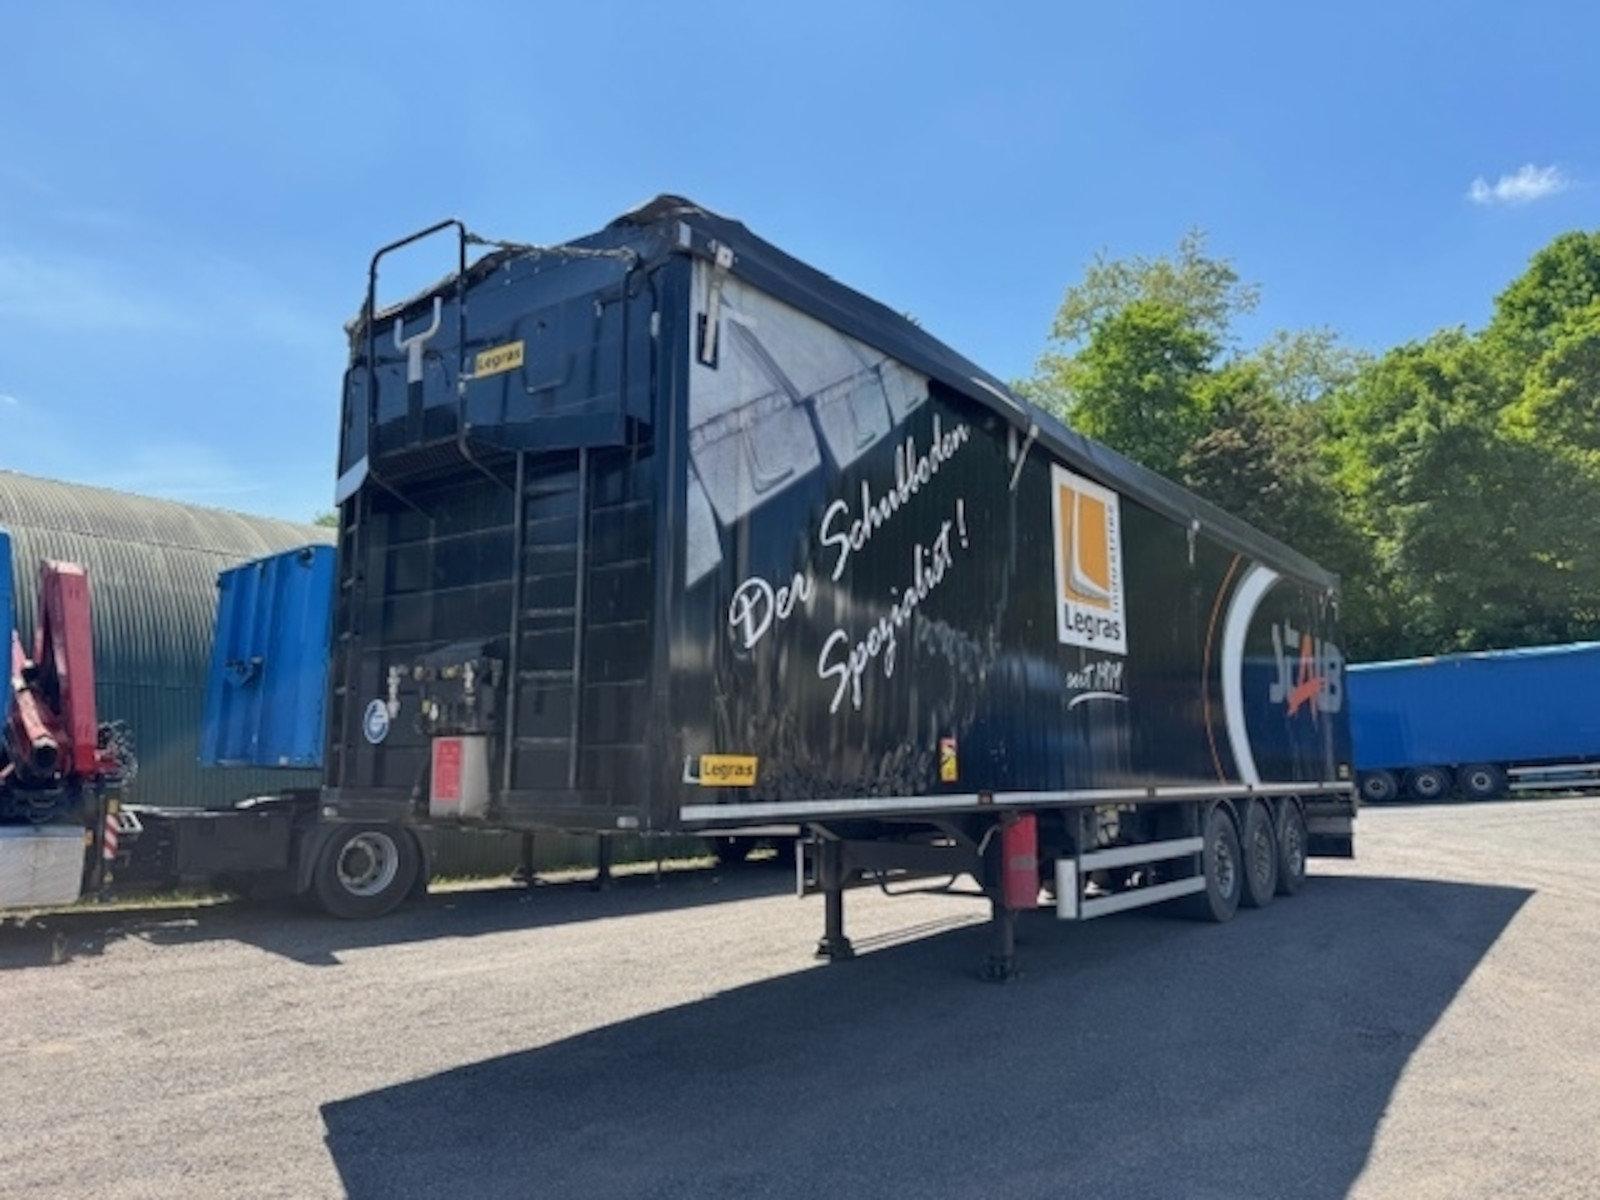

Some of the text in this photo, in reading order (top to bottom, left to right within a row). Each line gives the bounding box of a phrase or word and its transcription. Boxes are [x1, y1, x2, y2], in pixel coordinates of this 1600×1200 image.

[479, 349, 520, 370] Legras
[729, 576, 813, 648] Der
[1064, 602, 1121, 641] Legras
[703, 757, 754, 780] Legras
